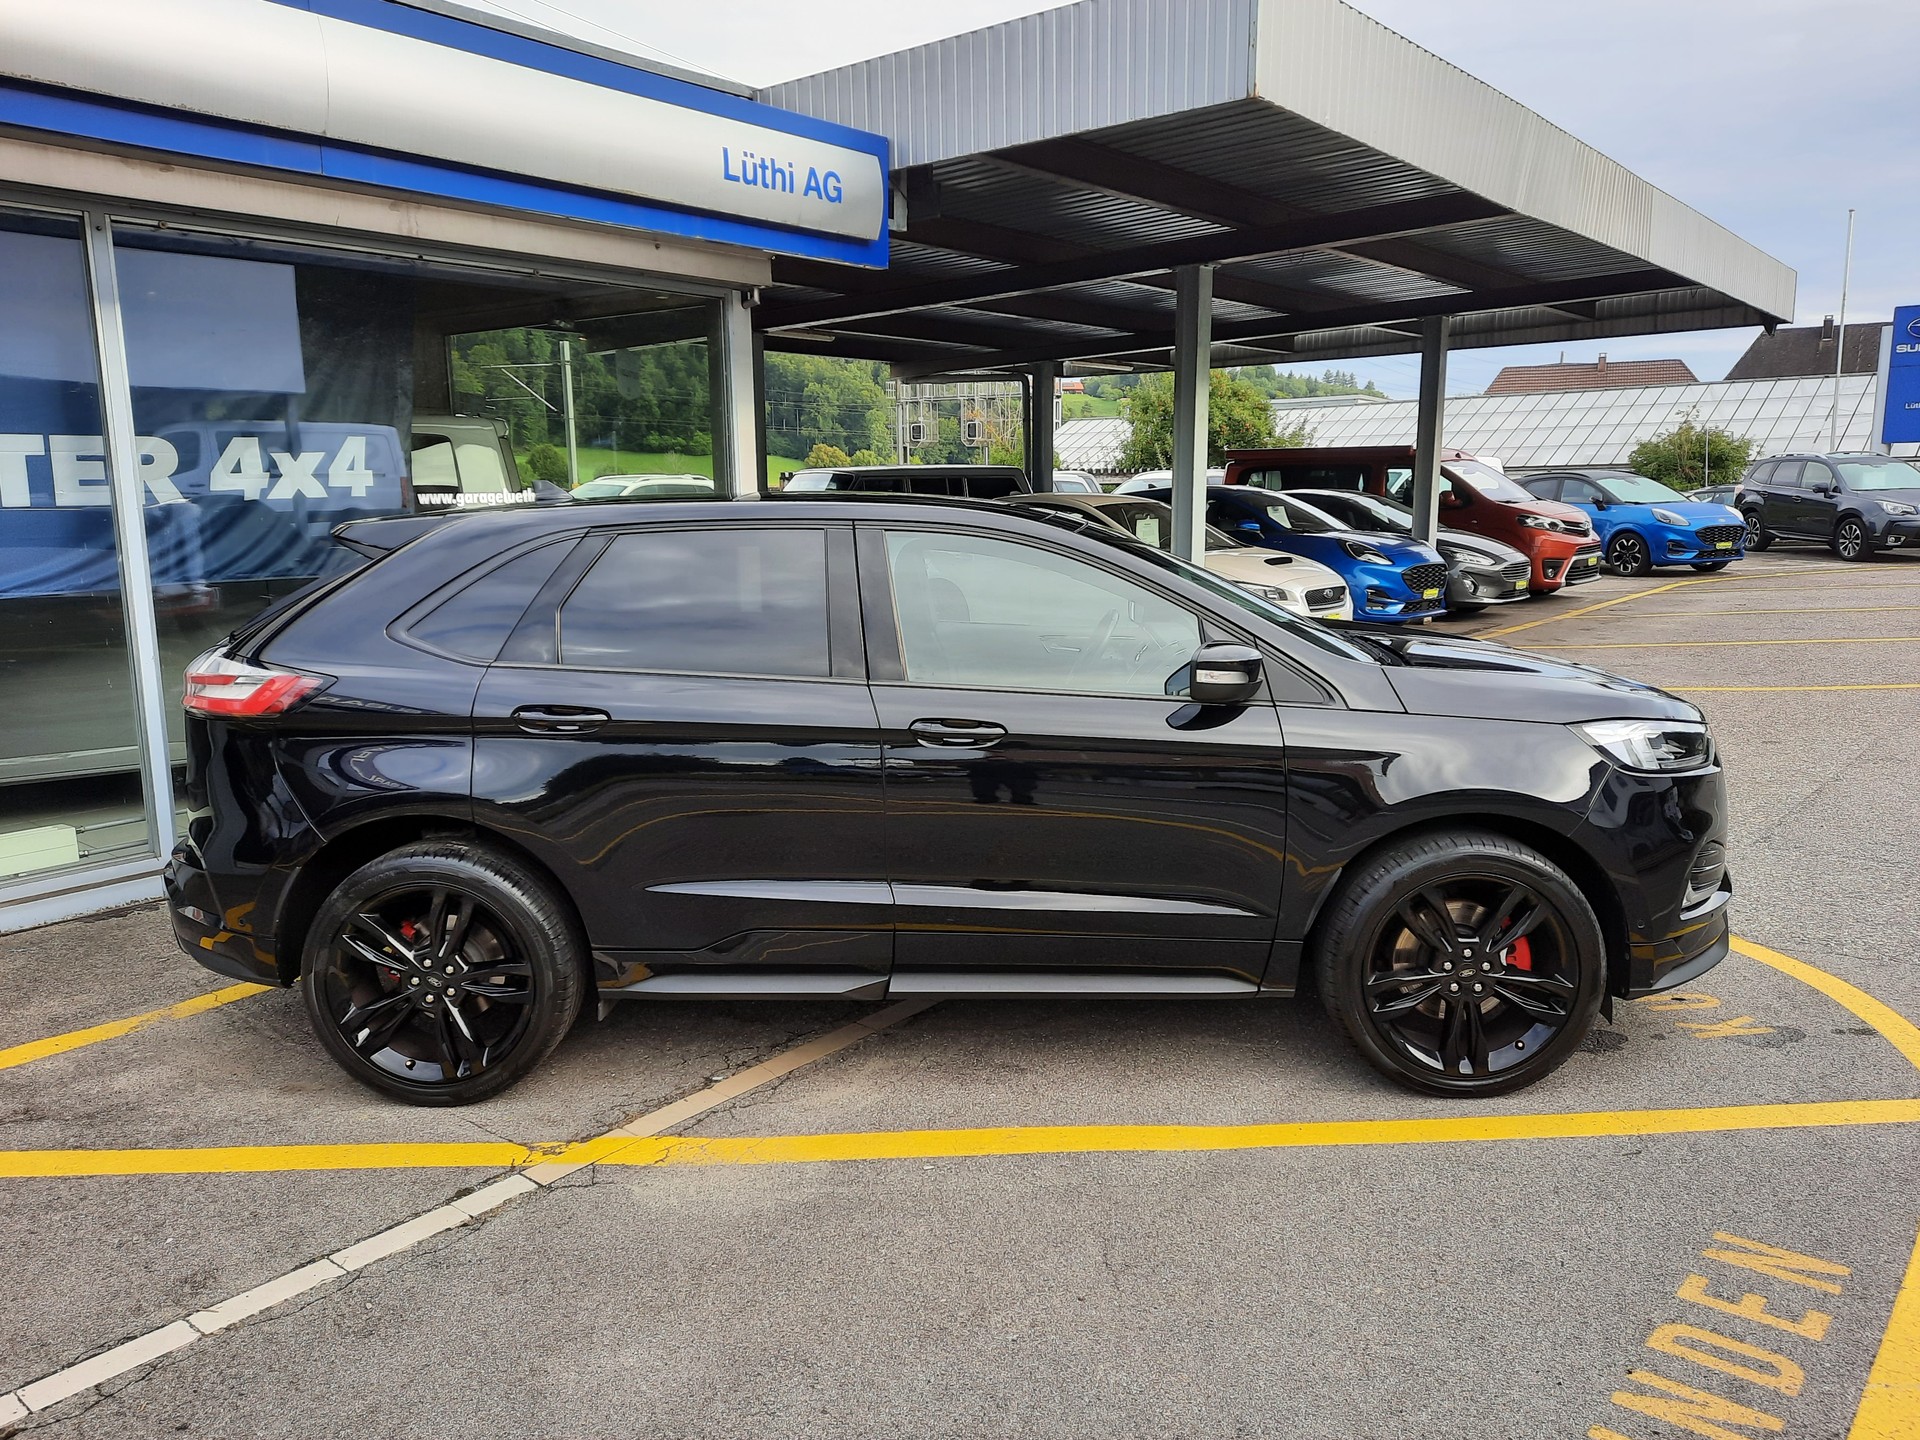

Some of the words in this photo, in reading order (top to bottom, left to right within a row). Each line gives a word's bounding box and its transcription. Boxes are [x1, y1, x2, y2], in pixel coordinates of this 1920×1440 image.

[722, 146, 795, 194] Lüthi
[803, 166, 842, 204] AG
[1896, 343, 1920, 354] SU
[210, 436, 375, 501] 4x4
[1587, 1232, 1851, 1440] NDEN
